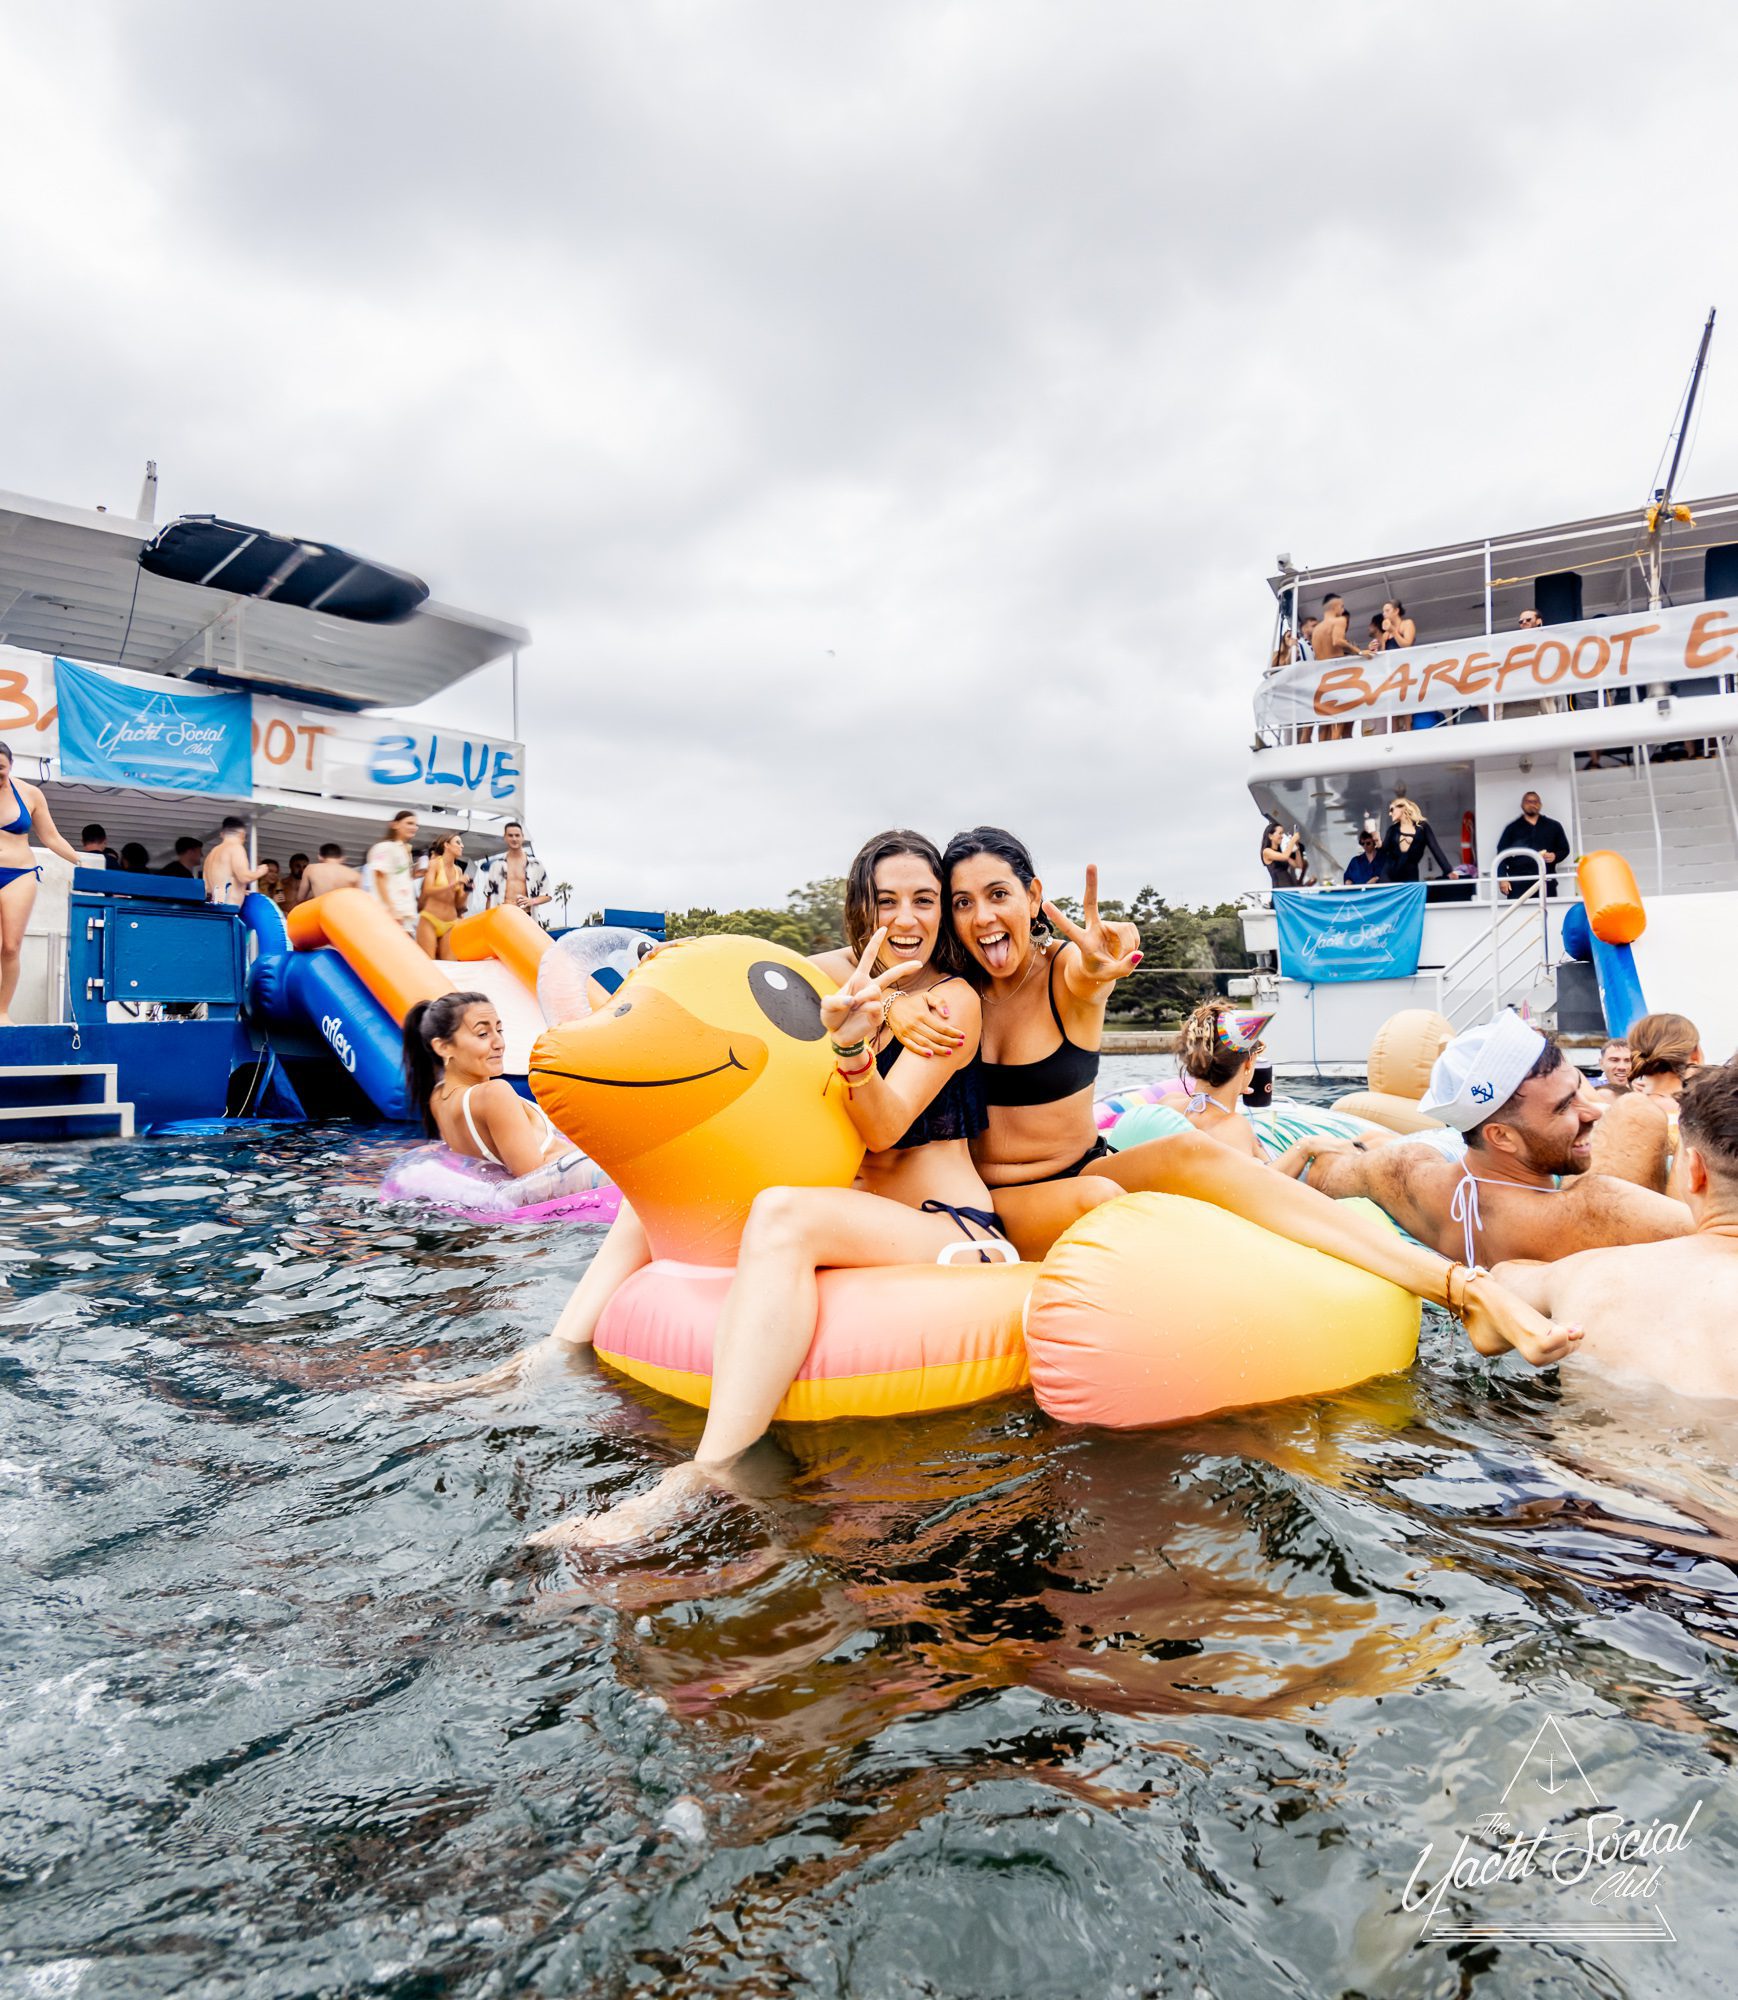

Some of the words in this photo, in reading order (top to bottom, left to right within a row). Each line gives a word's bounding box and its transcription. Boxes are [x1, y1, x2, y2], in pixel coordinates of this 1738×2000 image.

[1314, 624, 1660, 716] BAREFOOT
[1685, 610, 1738, 670] E
[96, 720, 178, 759] Yacht
[166, 721, 227, 746] Social
[183, 742, 213, 756] Club
[369, 734, 520, 799] BLUE
[1302, 929, 1349, 962] Yacht
